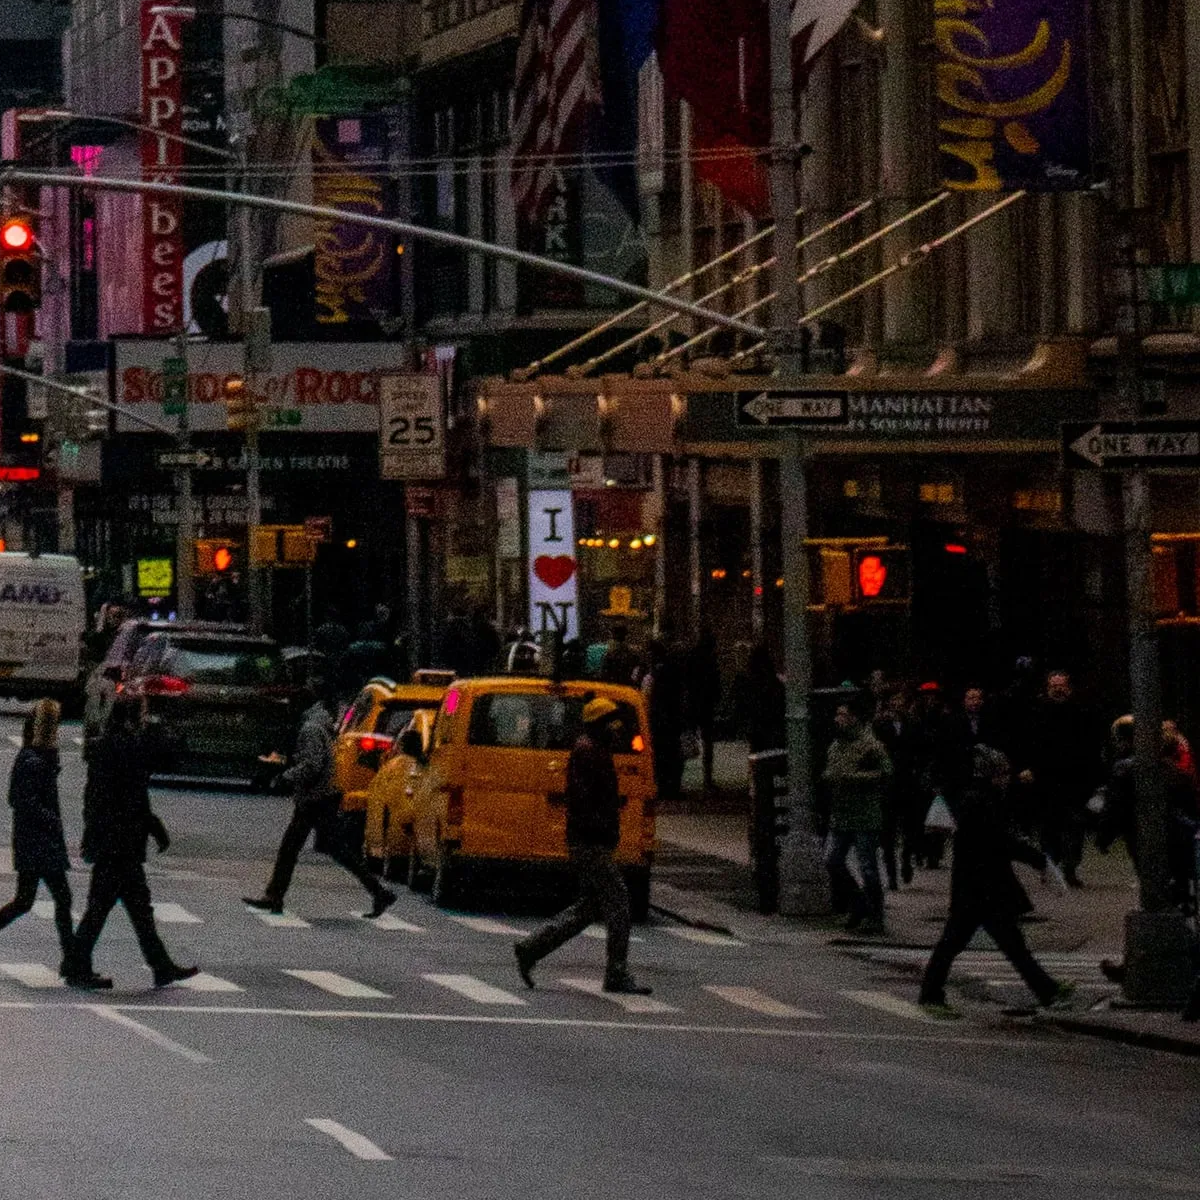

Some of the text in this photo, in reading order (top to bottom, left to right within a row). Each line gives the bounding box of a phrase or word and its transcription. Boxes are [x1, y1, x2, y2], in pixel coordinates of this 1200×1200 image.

[800, 401, 833, 414] WAY
[847, 394, 993, 415] MANHATTAN
[389, 416, 435, 445] 25
[1088, 435, 1188, 455] ONE WAY
[543, 507, 563, 542] I
